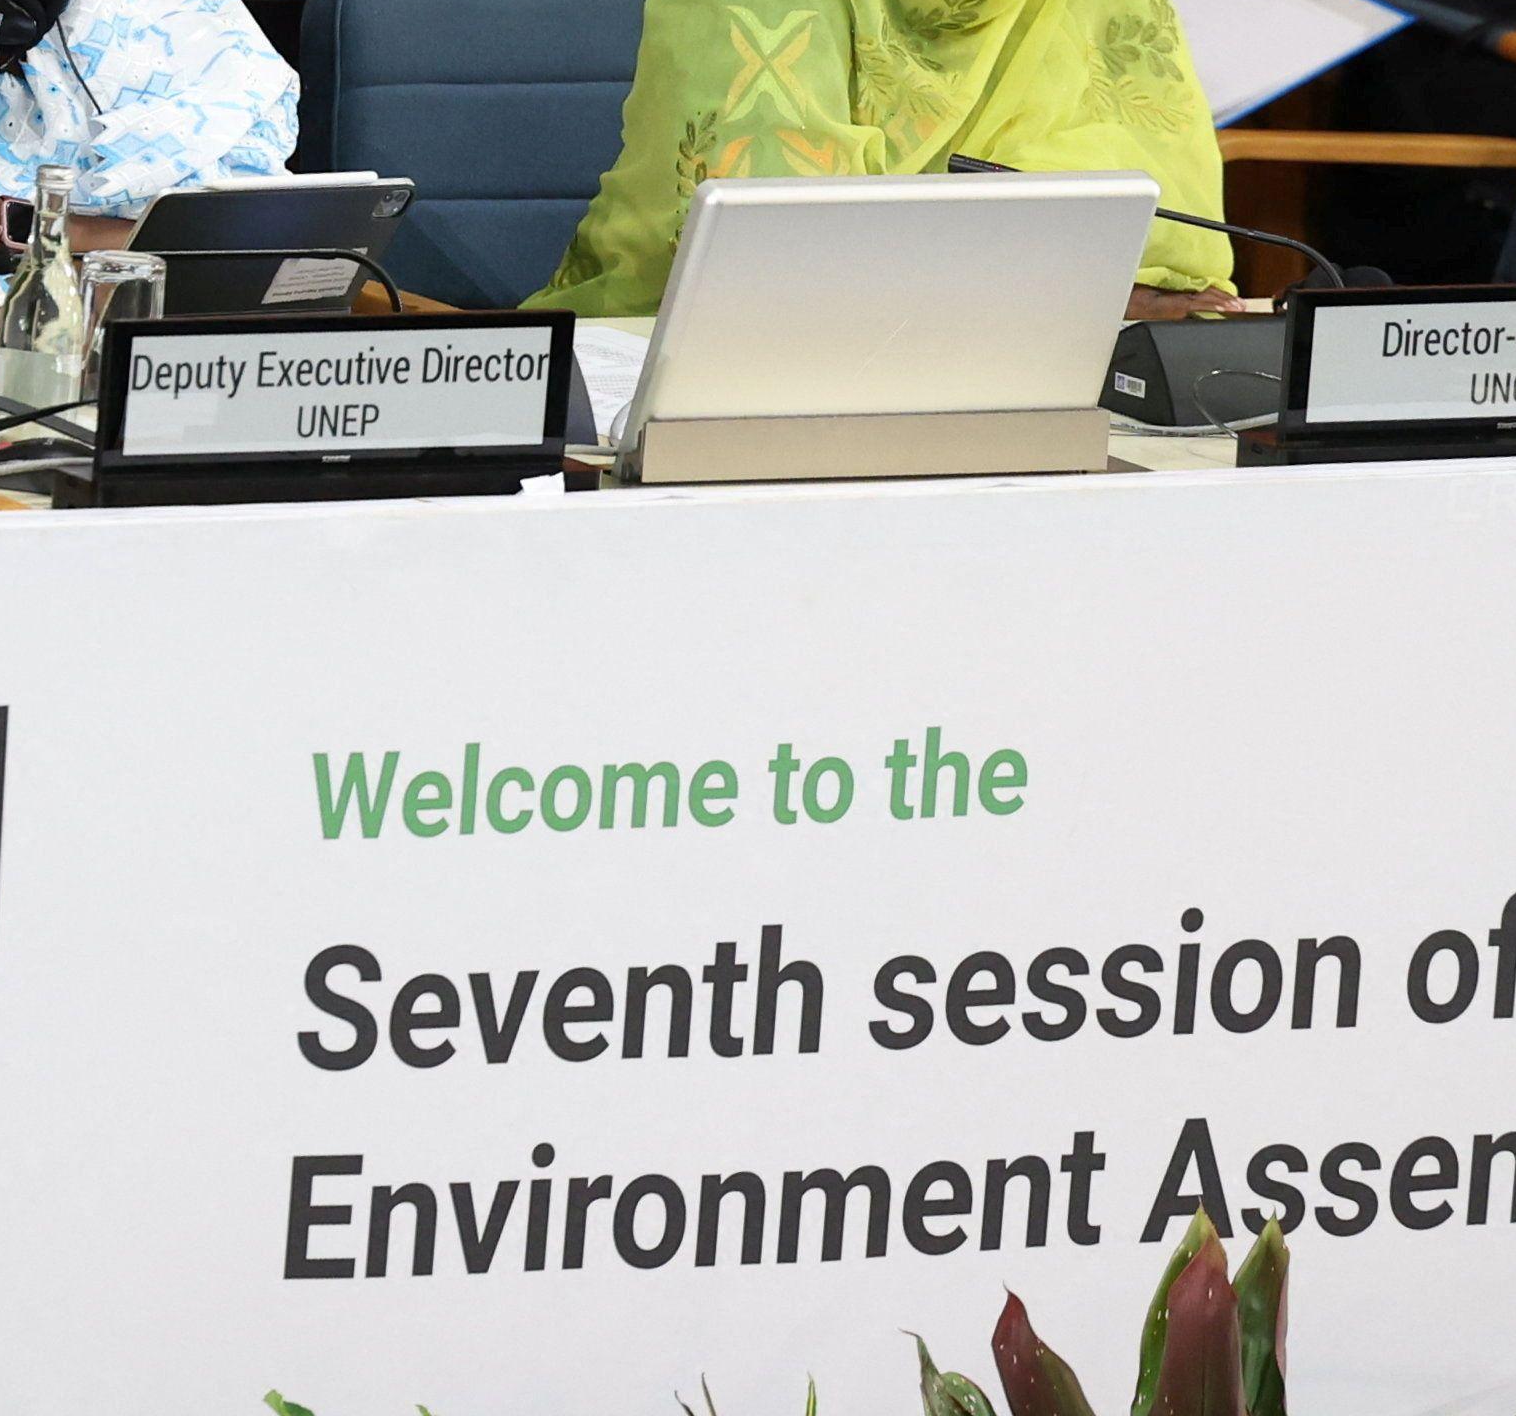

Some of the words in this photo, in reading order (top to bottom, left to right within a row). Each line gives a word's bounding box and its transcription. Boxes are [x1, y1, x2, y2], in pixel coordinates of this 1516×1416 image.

[131, 355, 246, 399] Deputy
[257, 346, 410, 387] Executive
[421, 344, 550, 383] Director
[297, 404, 379, 438] UNEP
[313, 743, 738, 840] Welcome
[768, 743, 854, 825] to
[885, 727, 1027, 820] the
[297, 924, 823, 1071] Seventh
[869, 908, 1361, 1036] session
[284, 1131, 1106, 1279] Environment
